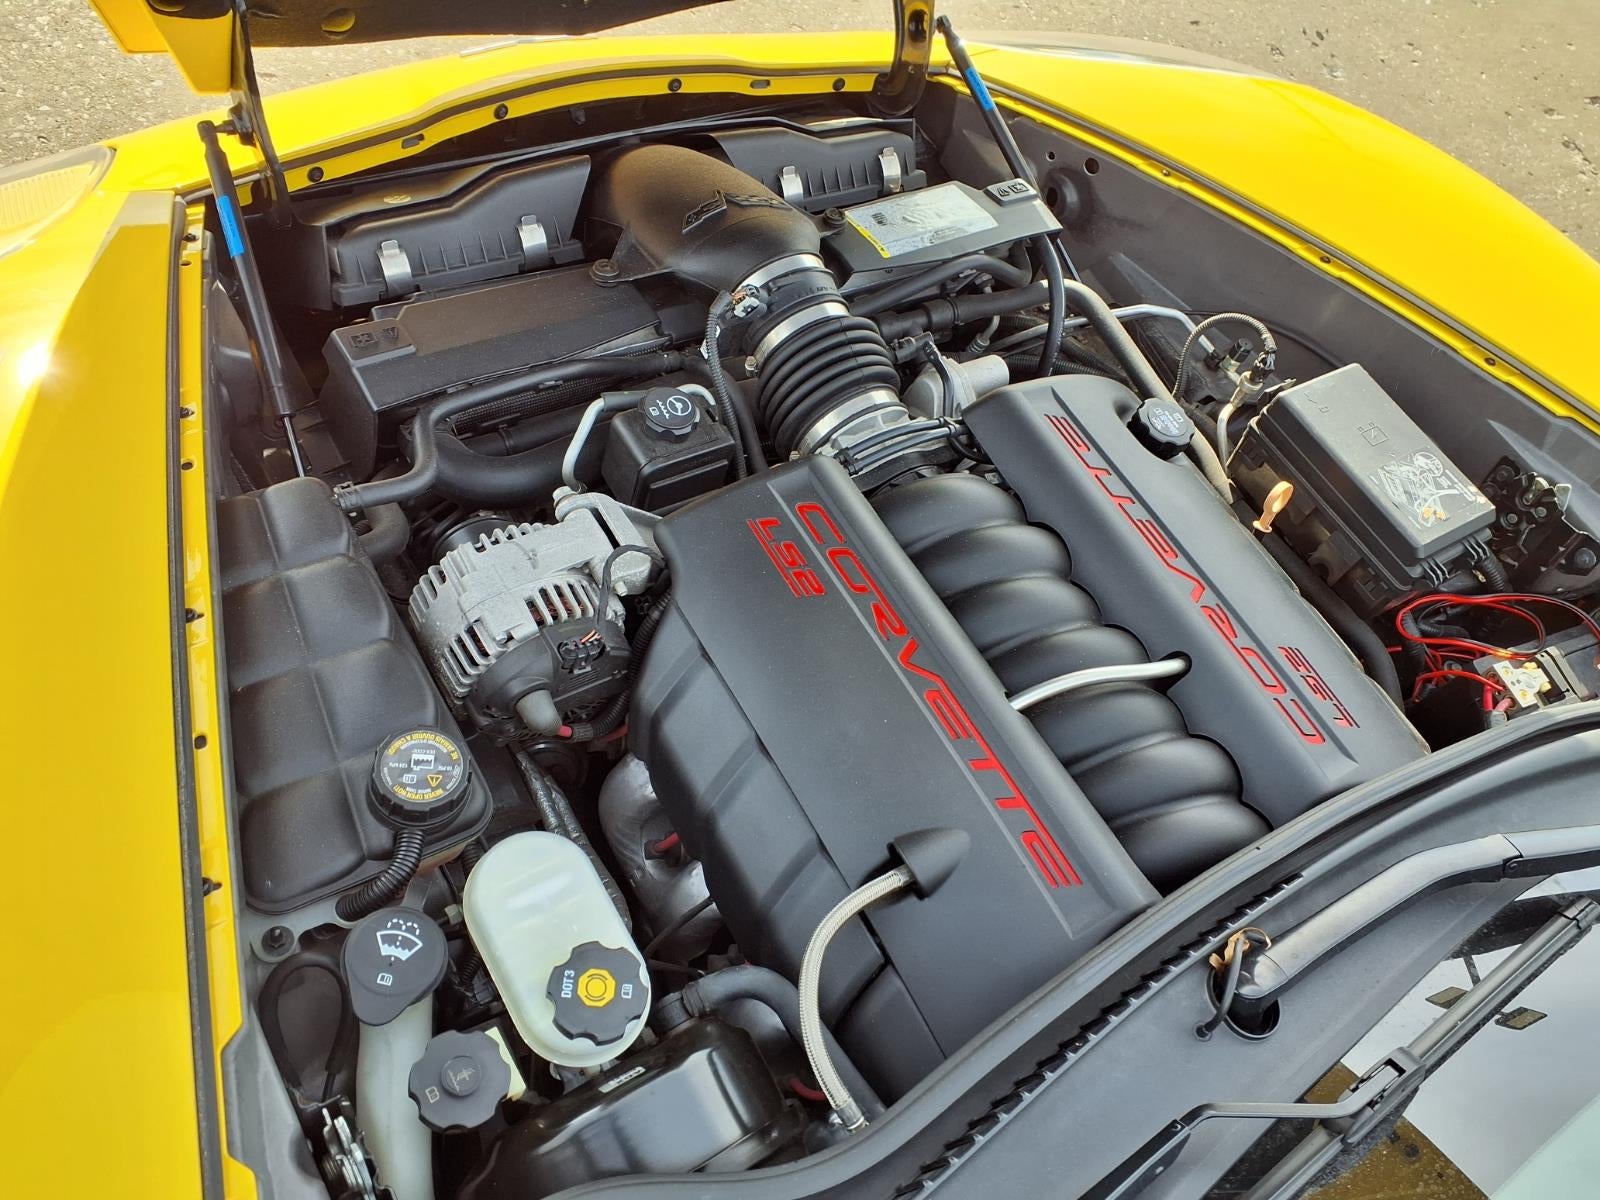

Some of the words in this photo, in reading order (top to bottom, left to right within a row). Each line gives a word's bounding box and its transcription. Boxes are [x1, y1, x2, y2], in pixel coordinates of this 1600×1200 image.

[746, 517, 827, 598] LS2
[1044, 413, 1326, 744] CORVETTE
[795, 502, 1083, 889] CORVETTE
[1278, 646, 1360, 729] LS2
[406, 791, 423, 800] OPEN
[423, 788, 444, 800] NEVER
